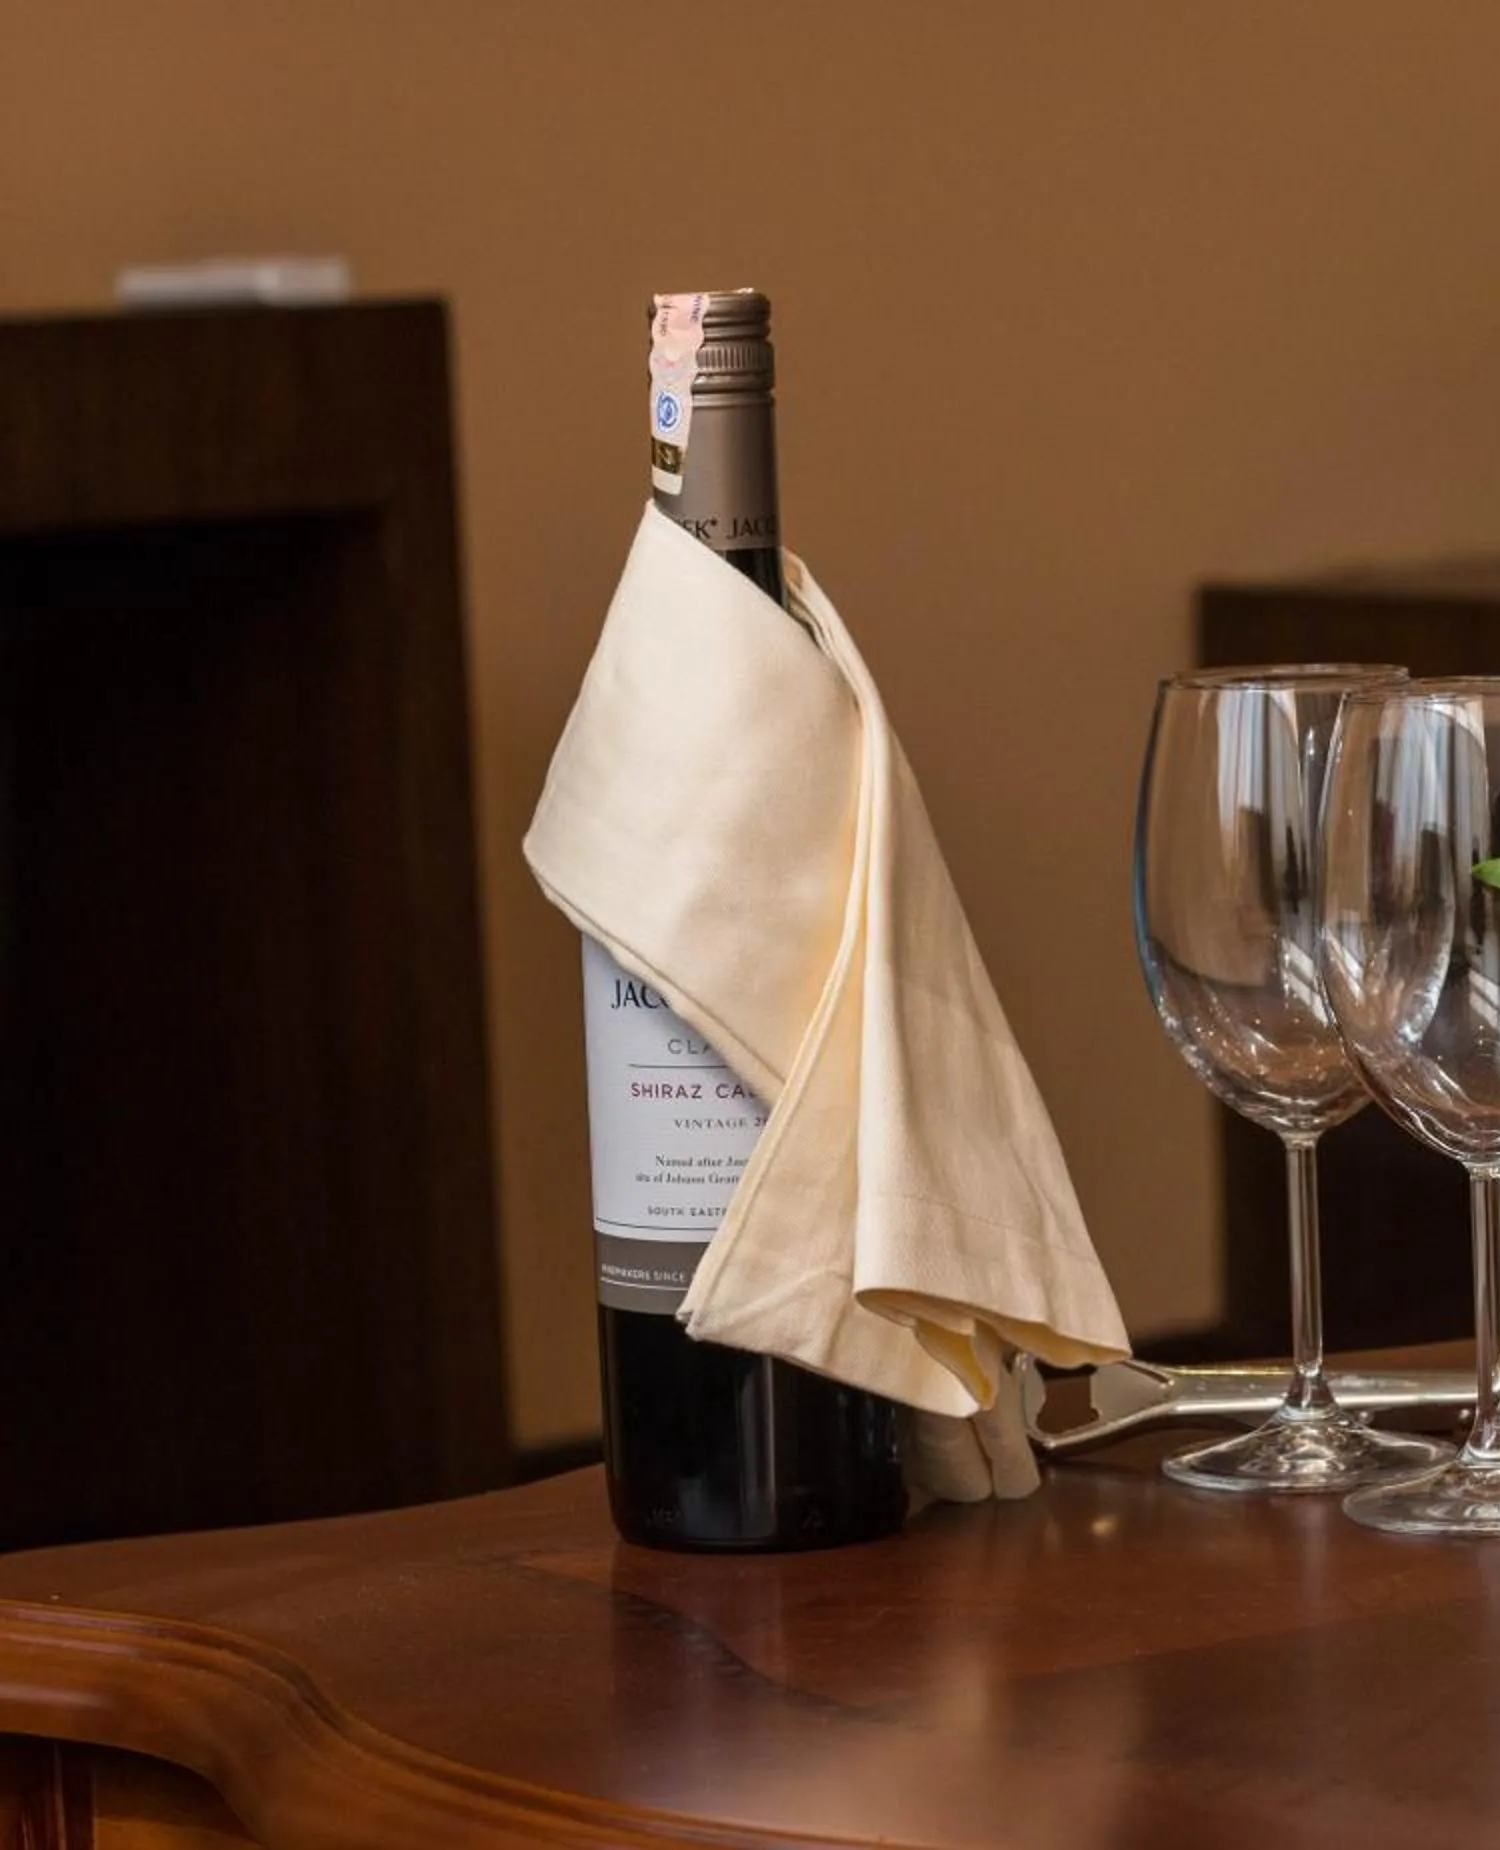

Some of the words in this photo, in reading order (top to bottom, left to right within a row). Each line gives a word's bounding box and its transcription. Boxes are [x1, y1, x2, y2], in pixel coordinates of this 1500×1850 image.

[631, 1082, 703, 1100] SHIRAZ
[673, 1117, 750, 1129] VINTAGE
[647, 1205, 685, 1217] SOUTH
